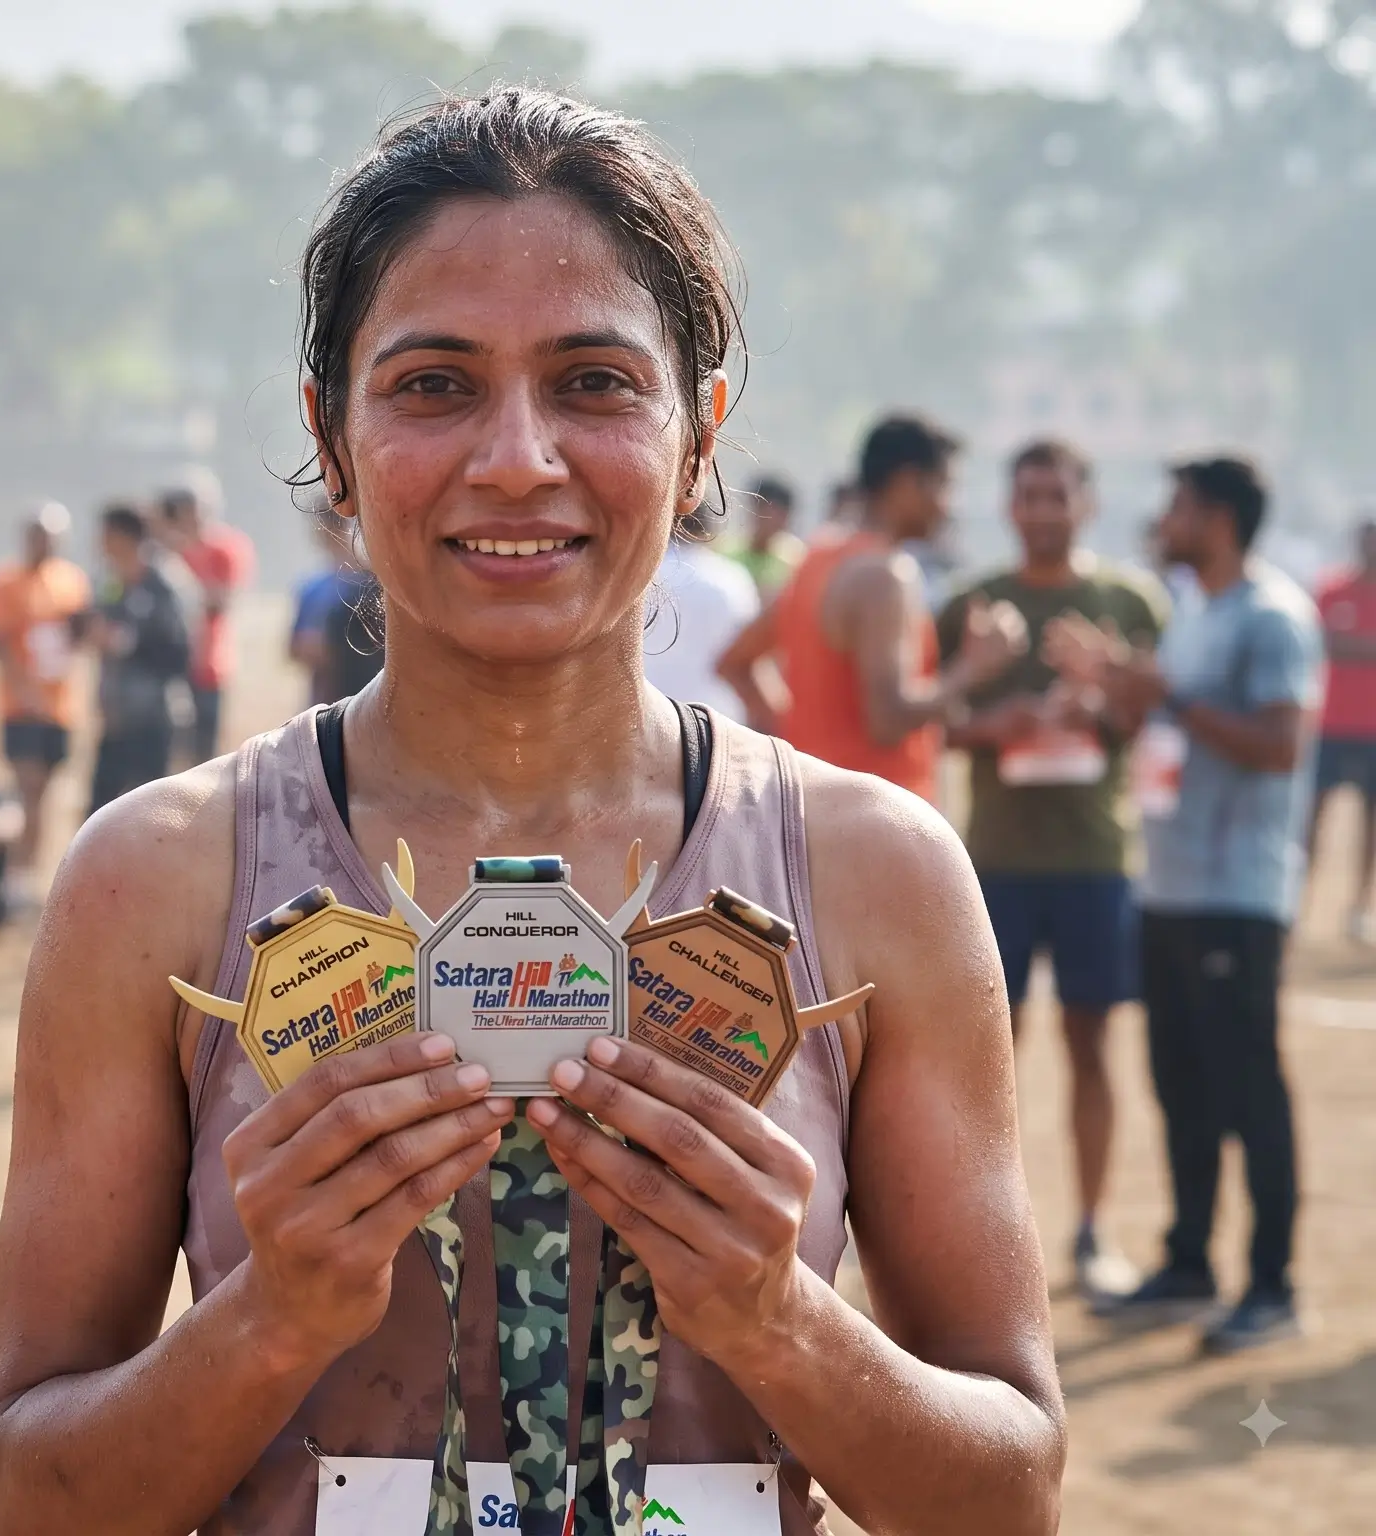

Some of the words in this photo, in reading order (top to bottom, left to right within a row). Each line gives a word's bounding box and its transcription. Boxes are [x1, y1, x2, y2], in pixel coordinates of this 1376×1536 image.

[463, 926, 579, 937] CONQUEROR
[506, 912, 537, 921] HILL
[270, 936, 370, 999] CHAMPION
[298, 945, 328, 964] HILL
[668, 940, 775, 1007] CHALLENGER
[713, 949, 741, 972] HILL
[433, 960, 513, 987] Satara
[508, 961, 553, 1008] Hill
[473, 989, 510, 1008] Half
[527, 988, 610, 1008] Marathon
[628, 956, 695, 1013] Satara
[261, 1003, 336, 1056] Satara
[331, 978, 368, 1039] Hill
[353, 985, 415, 1031] Maratho
[474, 1014, 494, 1027] The
[550, 1013, 607, 1027] Marathon
[642, 1000, 683, 1029] Half
[688, 1027, 764, 1079] Marathon
